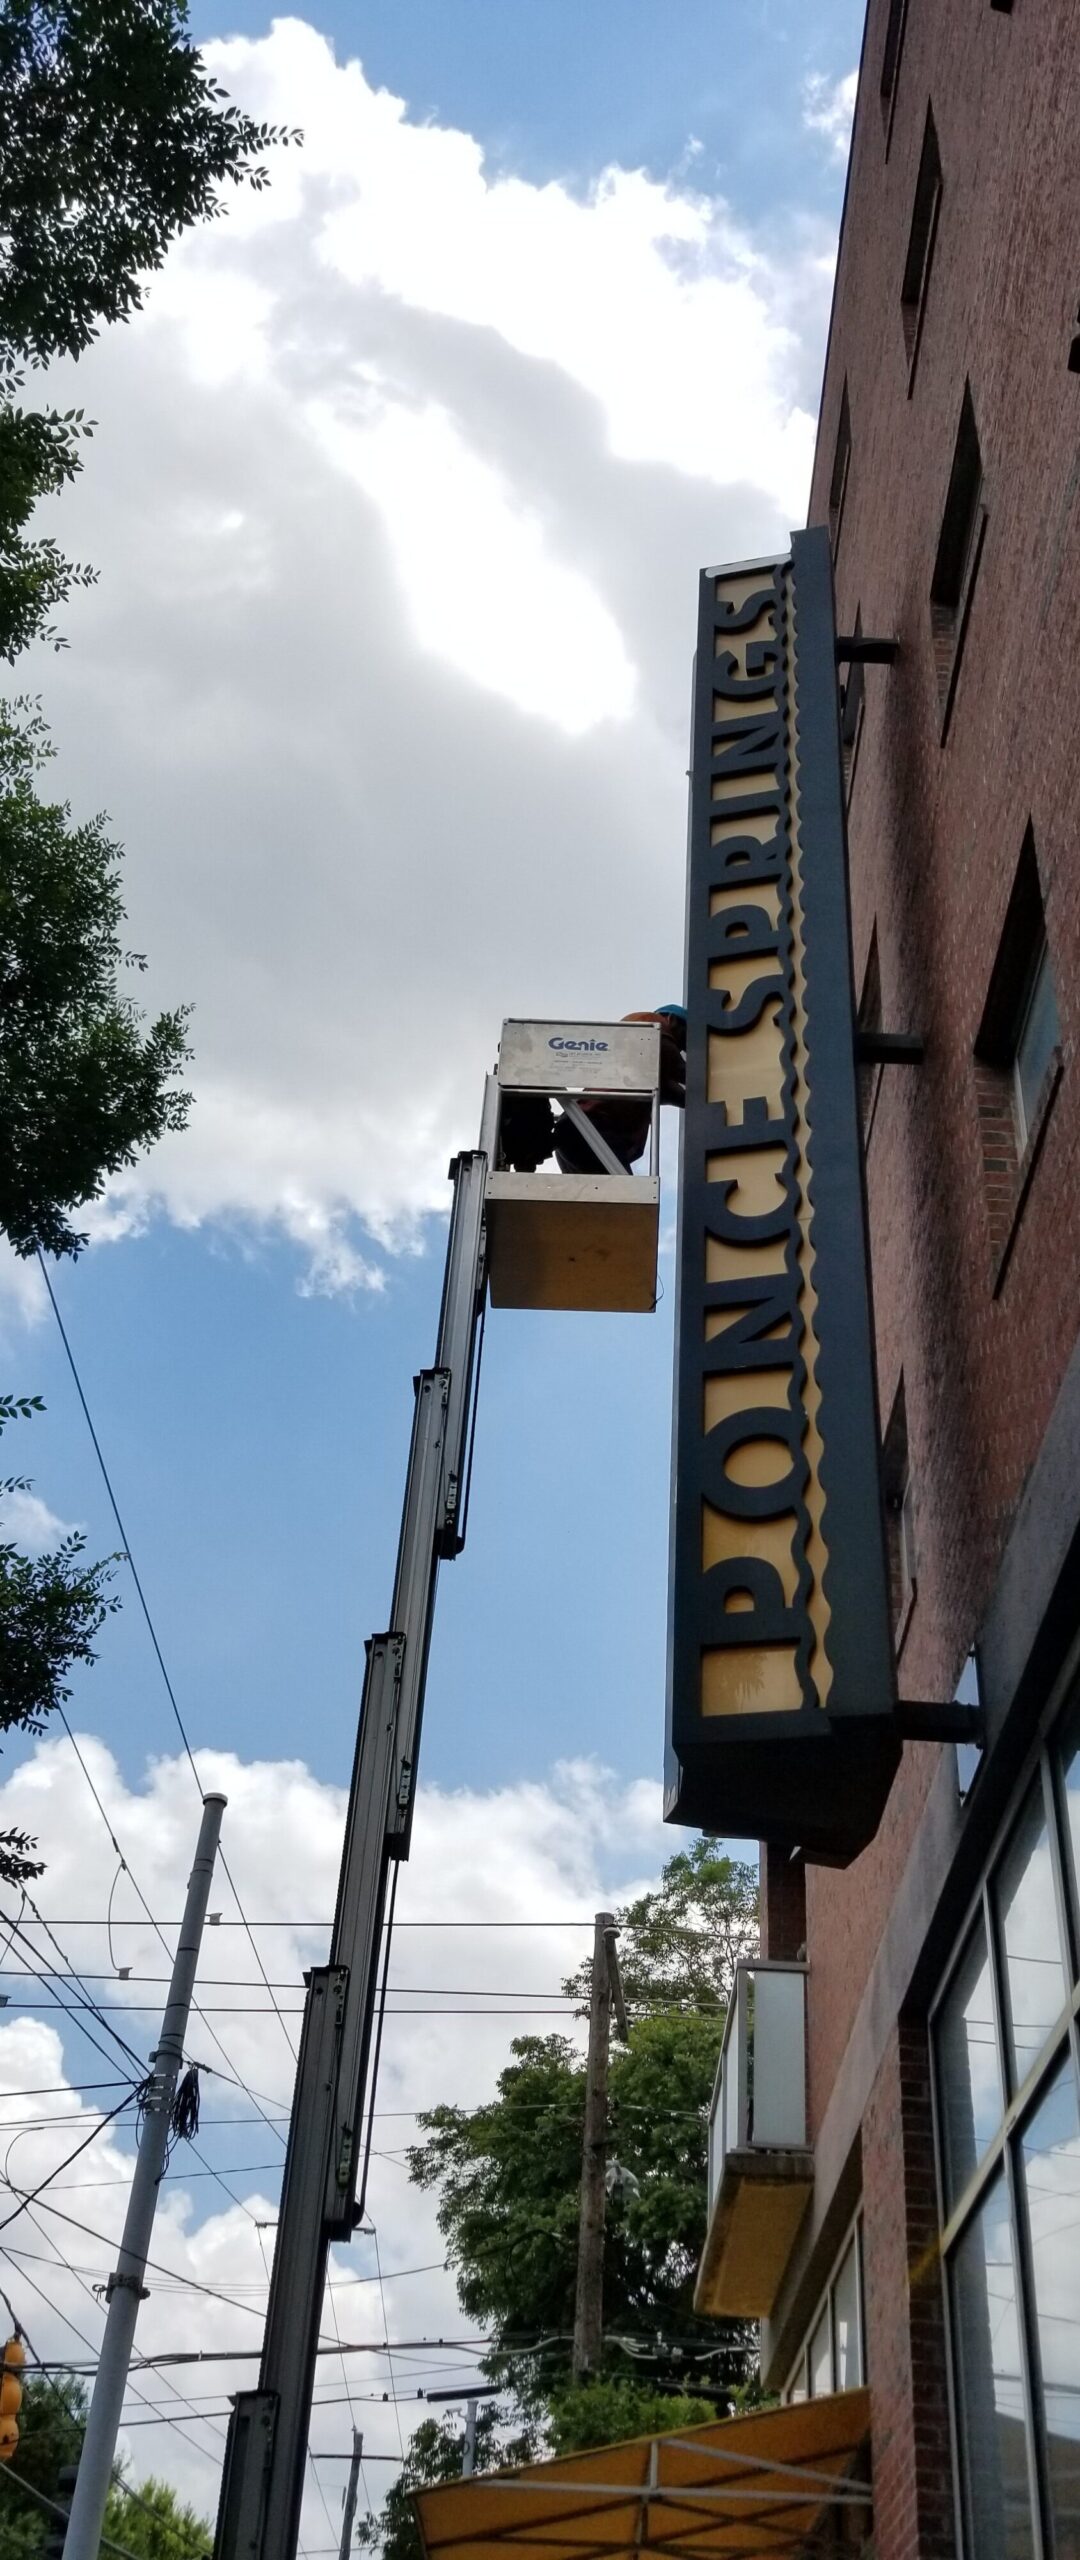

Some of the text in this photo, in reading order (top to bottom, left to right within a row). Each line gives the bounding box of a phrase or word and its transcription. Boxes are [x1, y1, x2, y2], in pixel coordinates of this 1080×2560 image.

[548, 1037, 609, 1051] Genie
[700, 587, 803, 1650] PONCE SPRINGS
